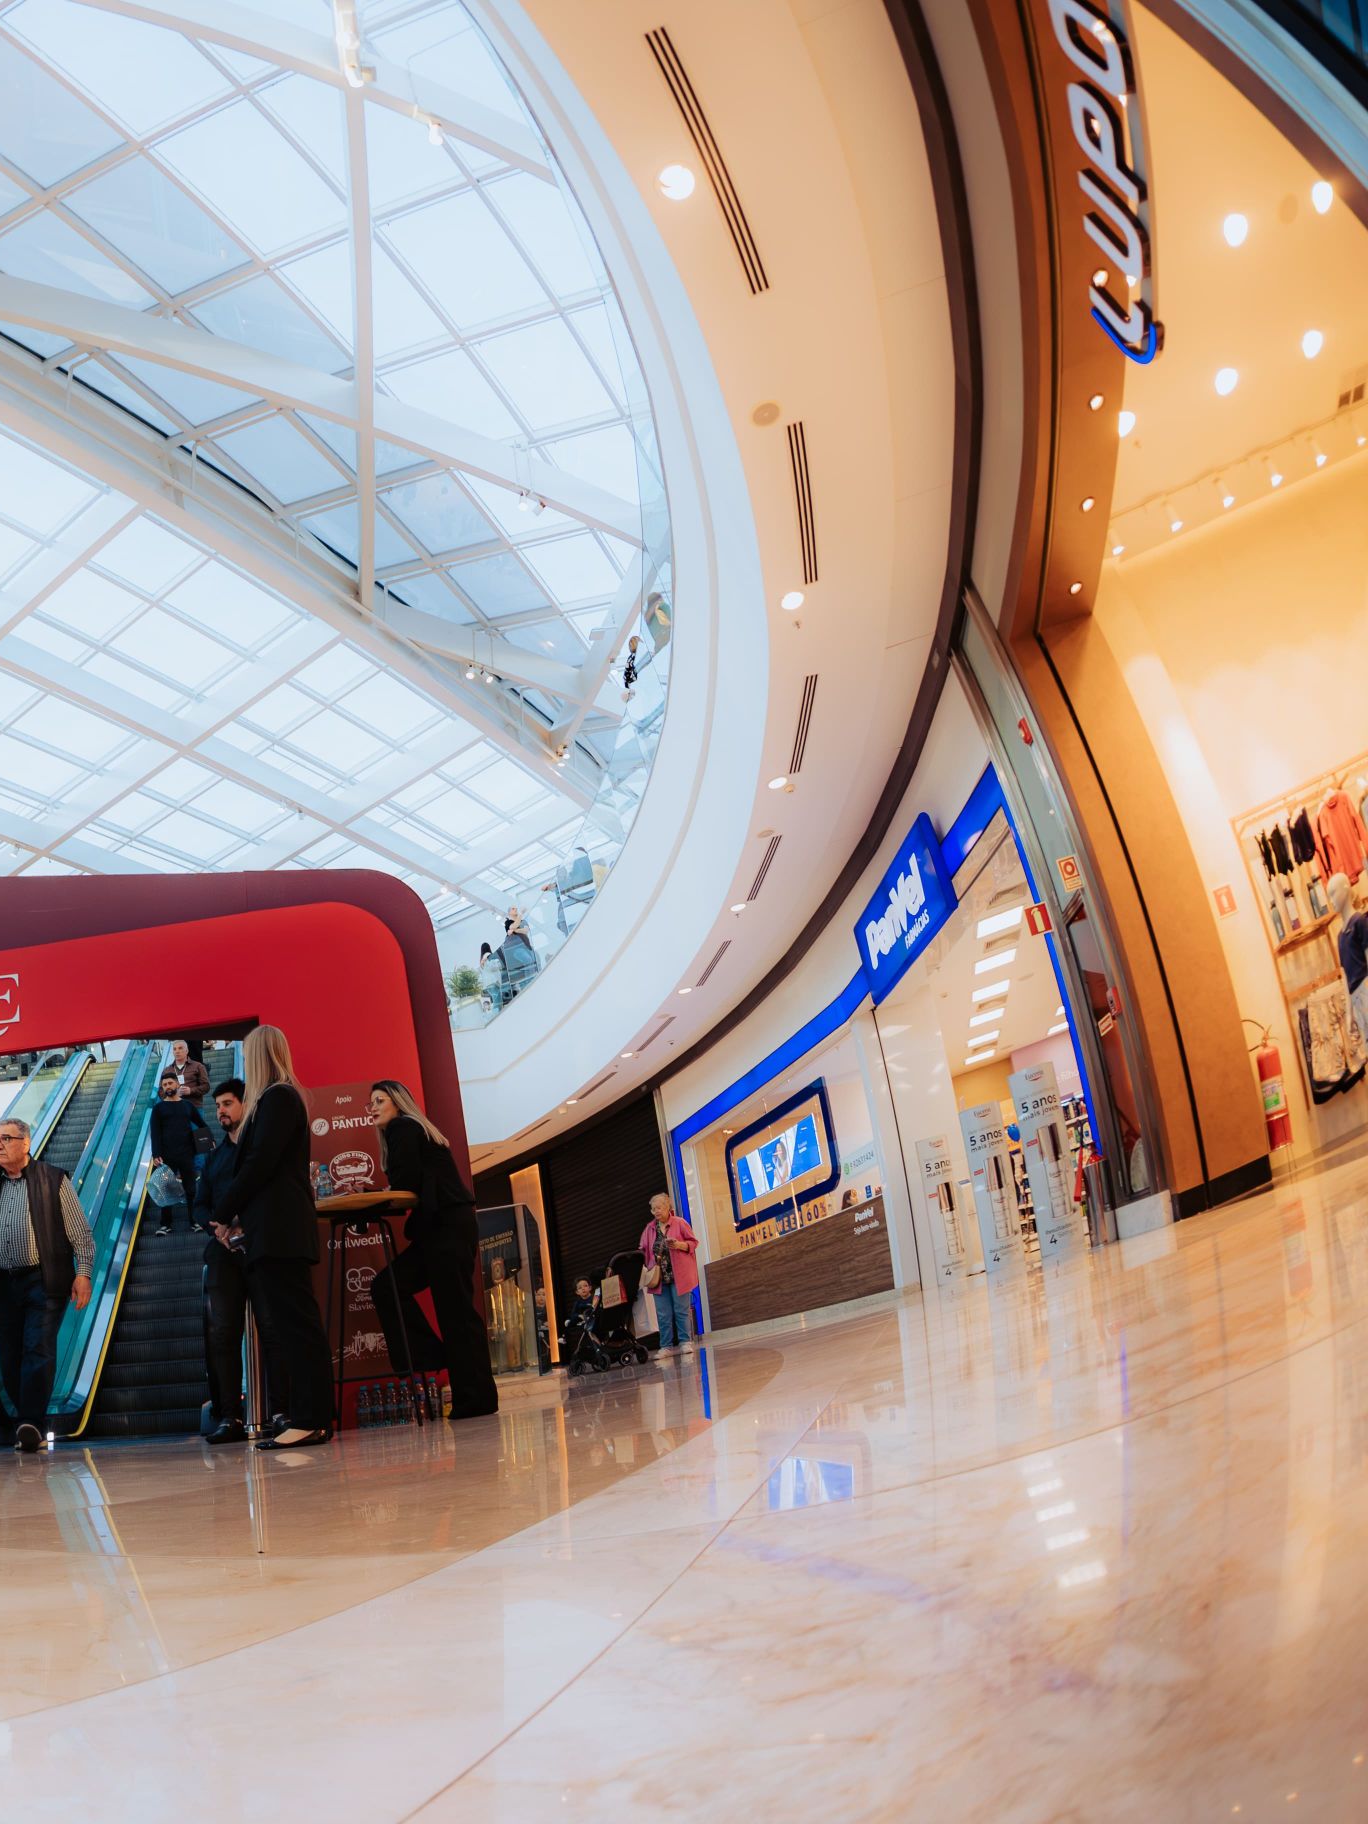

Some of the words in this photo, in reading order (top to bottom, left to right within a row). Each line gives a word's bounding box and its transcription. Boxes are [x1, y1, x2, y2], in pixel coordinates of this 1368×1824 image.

[865, 852, 926, 970] PanVel
[335, 1095, 352, 1105] Apoio
[1021, 1102, 1029, 1114] 5
[1032, 1094, 1057, 1109] anos
[332, 1115, 375, 1130] PANTUC
[969, 1136, 977, 1147] 5
[979, 1129, 1003, 1143] anos
[925, 1163, 932, 1173] 5
[934, 1160, 951, 1170] ano
[740, 1224, 773, 1248] PANVEL
[348, 1303, 376, 1312] Slavie
